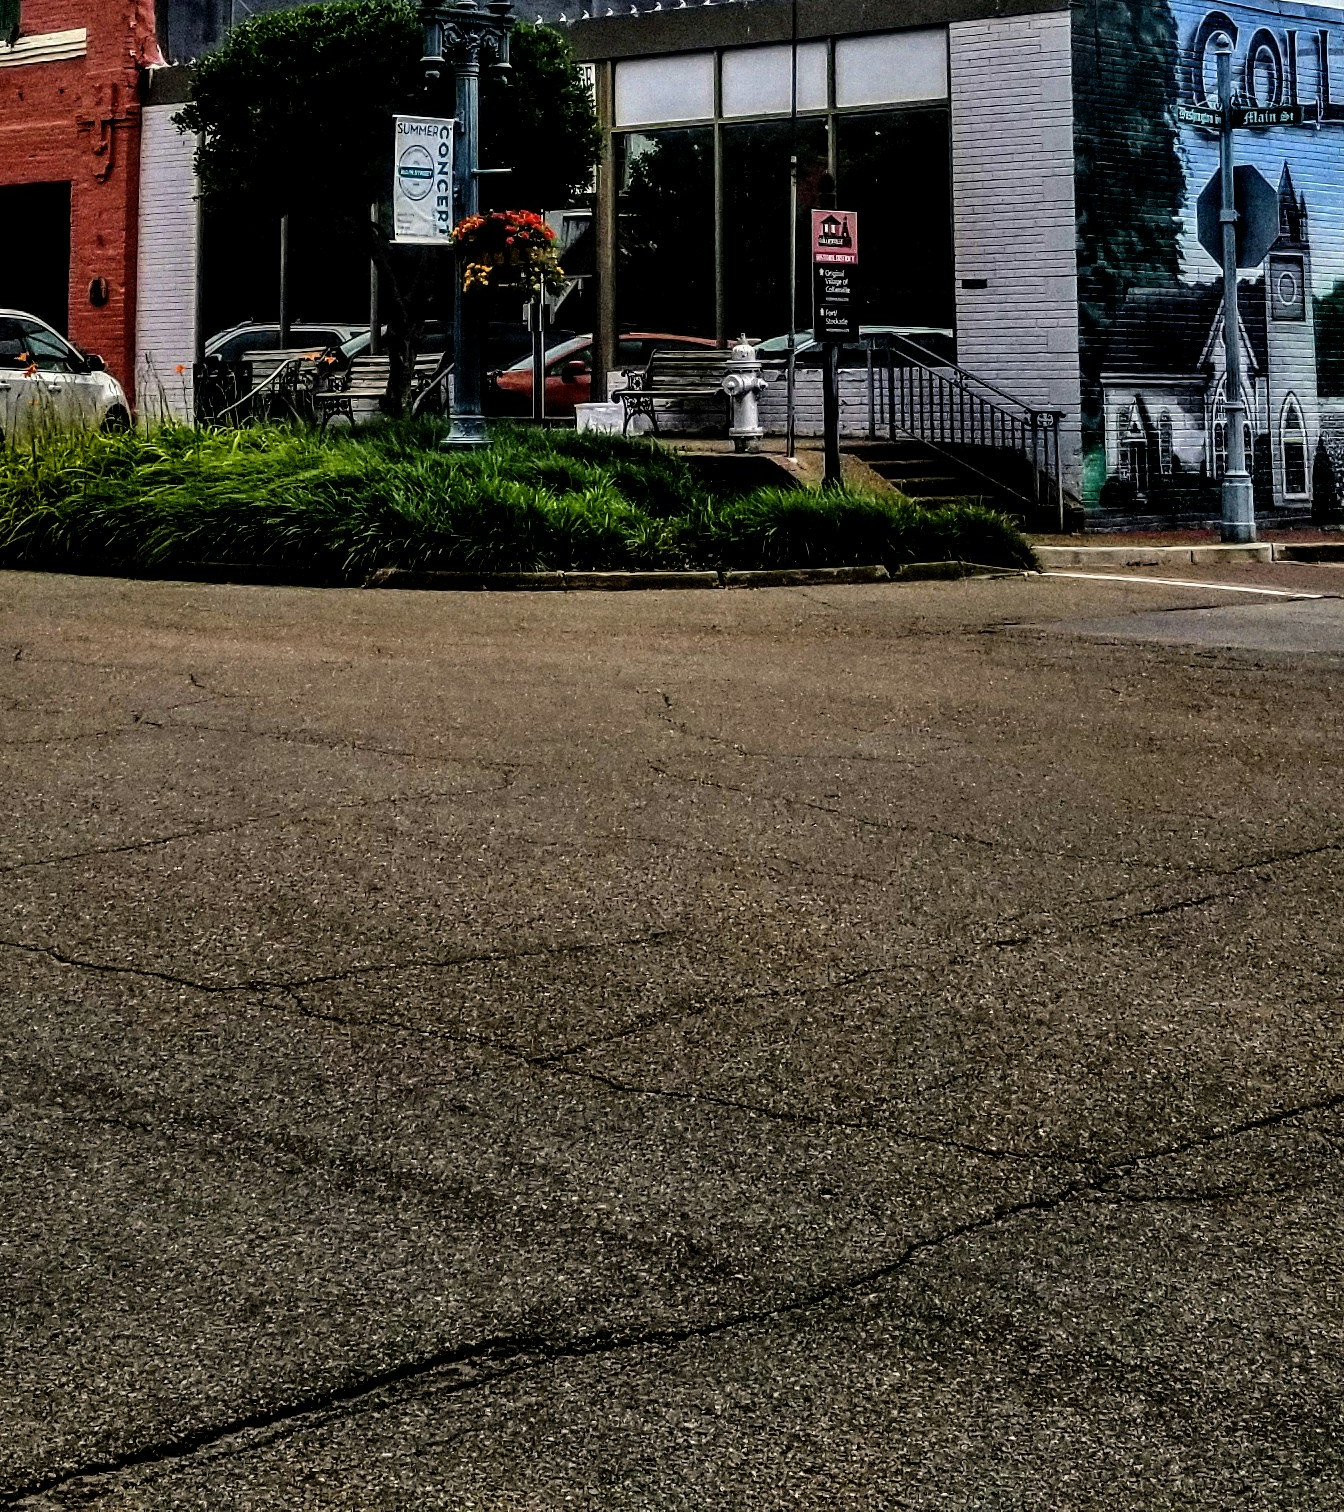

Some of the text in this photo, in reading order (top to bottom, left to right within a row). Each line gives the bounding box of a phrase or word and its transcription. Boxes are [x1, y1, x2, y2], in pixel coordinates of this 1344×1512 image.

[1243, 111, 1294, 125] Main St
[397, 122, 438, 138] SUMMER
[436, 125, 451, 235] CONCERT
